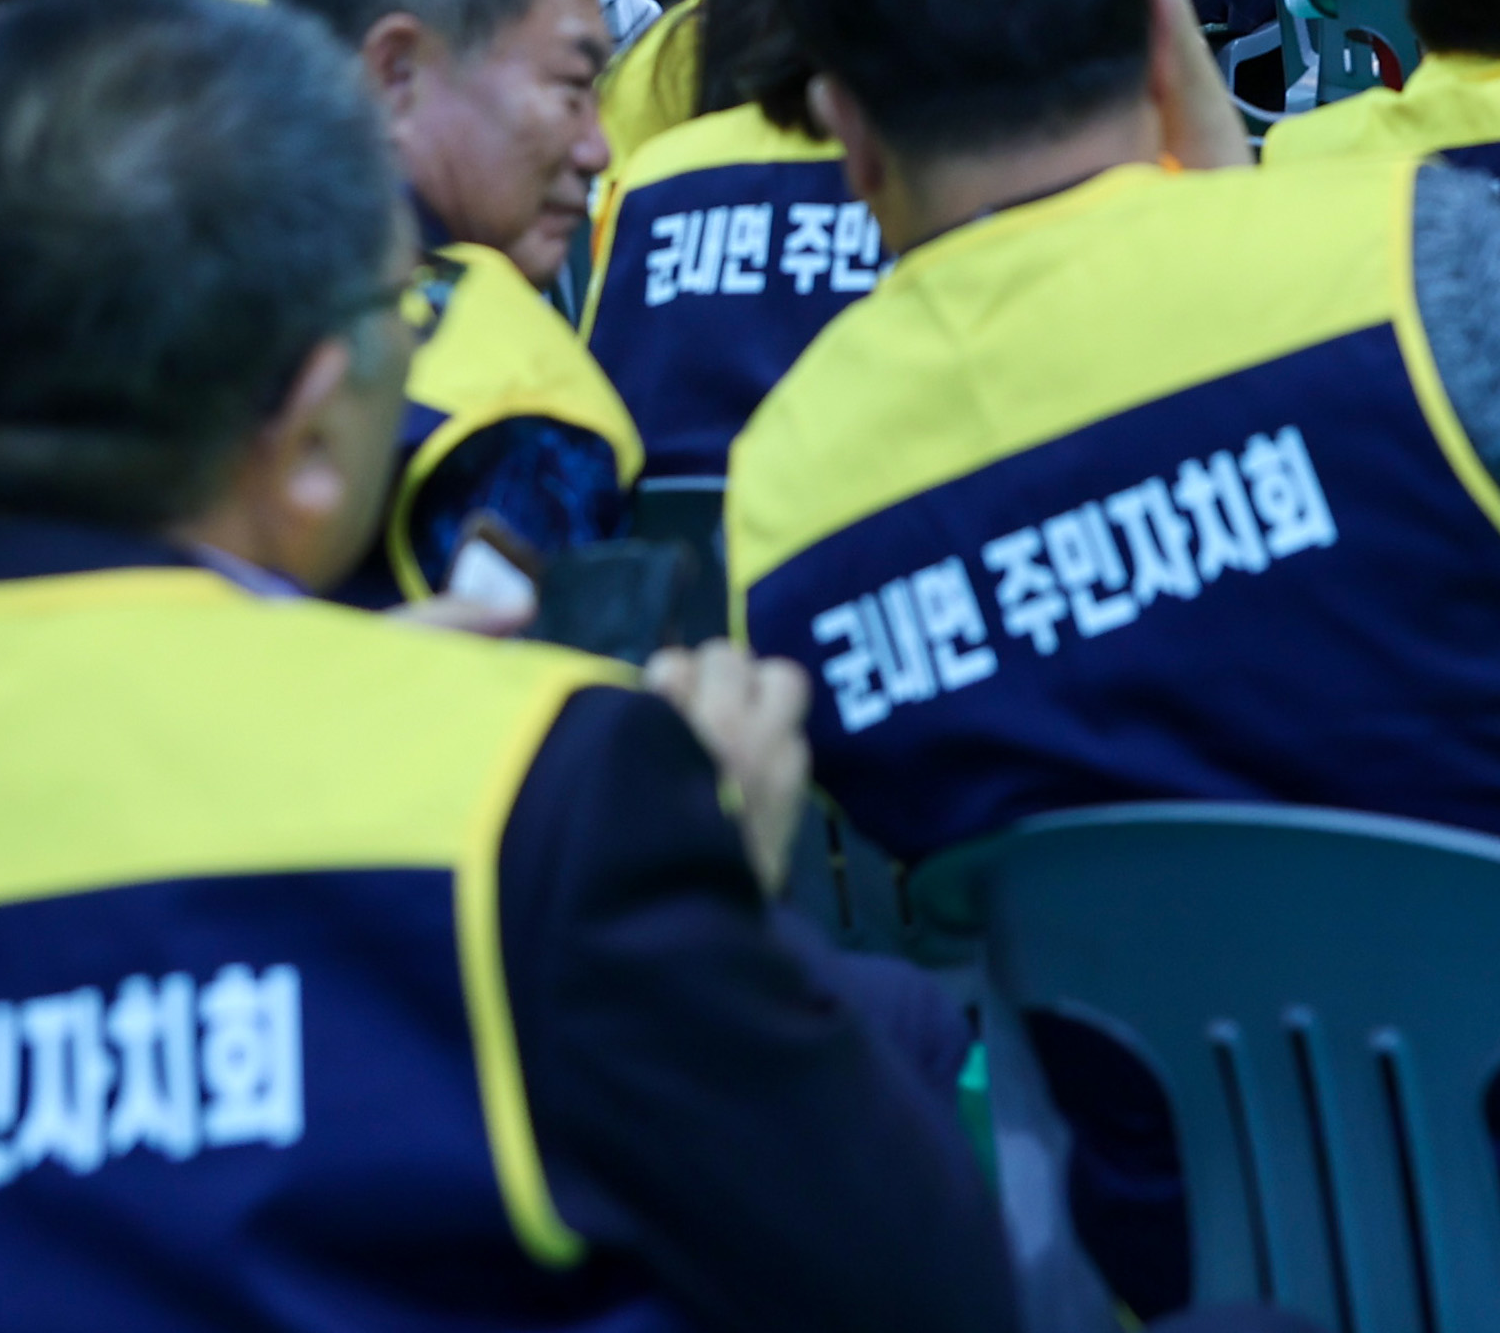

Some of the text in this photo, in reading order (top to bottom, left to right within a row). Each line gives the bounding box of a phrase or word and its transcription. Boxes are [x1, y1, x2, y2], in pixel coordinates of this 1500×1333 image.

[644, 200, 775, 309] 군내면
[811, 423, 1340, 734] 군내면 주민자치회
